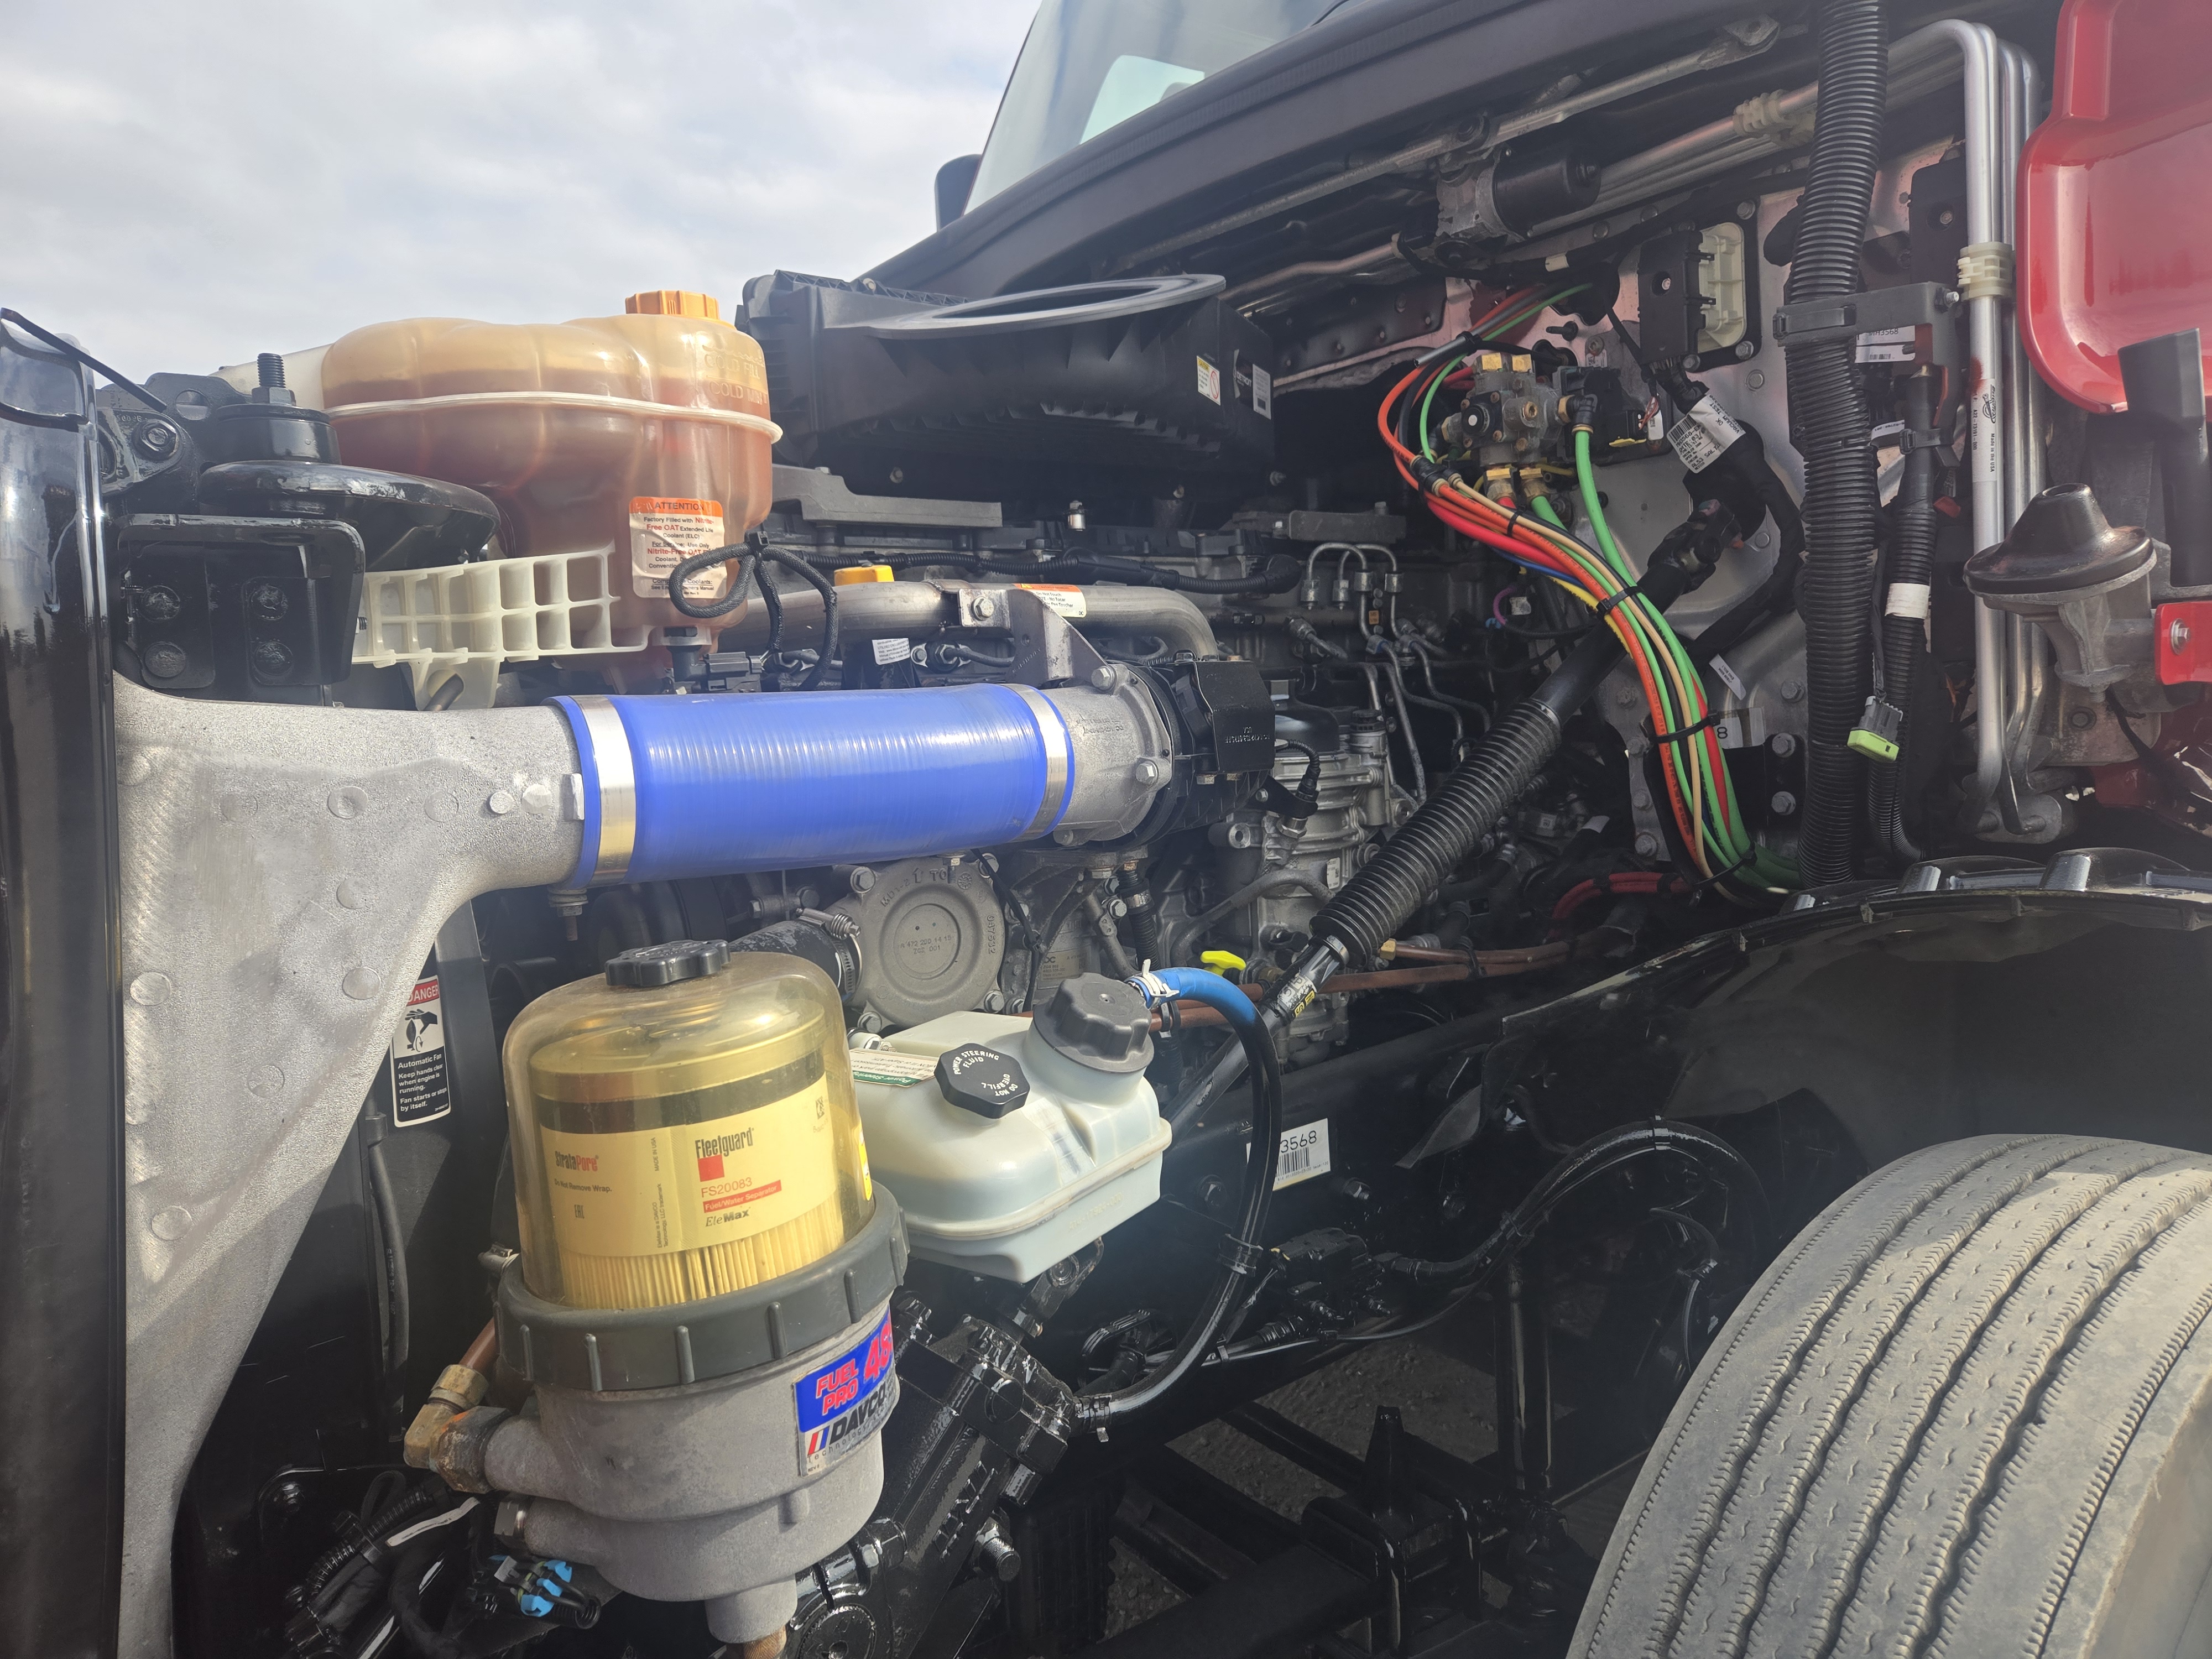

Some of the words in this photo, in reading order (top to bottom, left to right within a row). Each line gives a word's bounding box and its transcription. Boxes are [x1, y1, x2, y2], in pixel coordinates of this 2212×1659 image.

[1237, 371, 1252, 387] DETROIT
[709, 381, 744, 399] COLD
[1709, 403, 1721, 415] TEST
[1715, 418, 1724, 426] OK
[1722, 415, 1740, 434] VACUUM
[655, 502, 705, 512] ATTENTION
[398, 1056, 433, 1070] Automatic
[434, 1053, 442, 1062] Fan
[952, 1056, 963, 1075] POWER
[961, 1050, 1000, 1061] STEERING
[962, 1056, 984, 1068] FLUID
[398, 1070, 415, 1080] Keep
[416, 1067, 433, 1077] hands
[434, 1063, 444, 1072] clear
[853, 1071, 884, 1080] Steering
[399, 1079, 416, 1087] when
[417, 1074, 436, 1084] engine
[399, 1083, 426, 1094] running.
[980, 1073, 1011, 1090] OVERFILL
[1009, 1083, 1019, 1092] DO
[400, 1095, 412, 1104] Fan
[413, 1092, 431, 1102] starts
[437, 1087, 447, 1096] stops
[410, 1101, 428, 1110] itself.
[695, 1127, 754, 1159] Fleetguard
[560, 1180, 568, 1189] Not
[569, 1182, 591, 1192] Remove
[592, 1185, 613, 1193] Wrap.
[701, 1177, 753, 1198] FS20083
[705, 1196, 744, 1211] Fuel/Water
[745, 1185, 778, 1201] Separator
[706, 1208, 750, 1227] EleMax
[816, 1358, 859, 1399] FUEL
[822, 1377, 858, 1416] PRO
[830, 1380, 886, 1446] DAVCO
